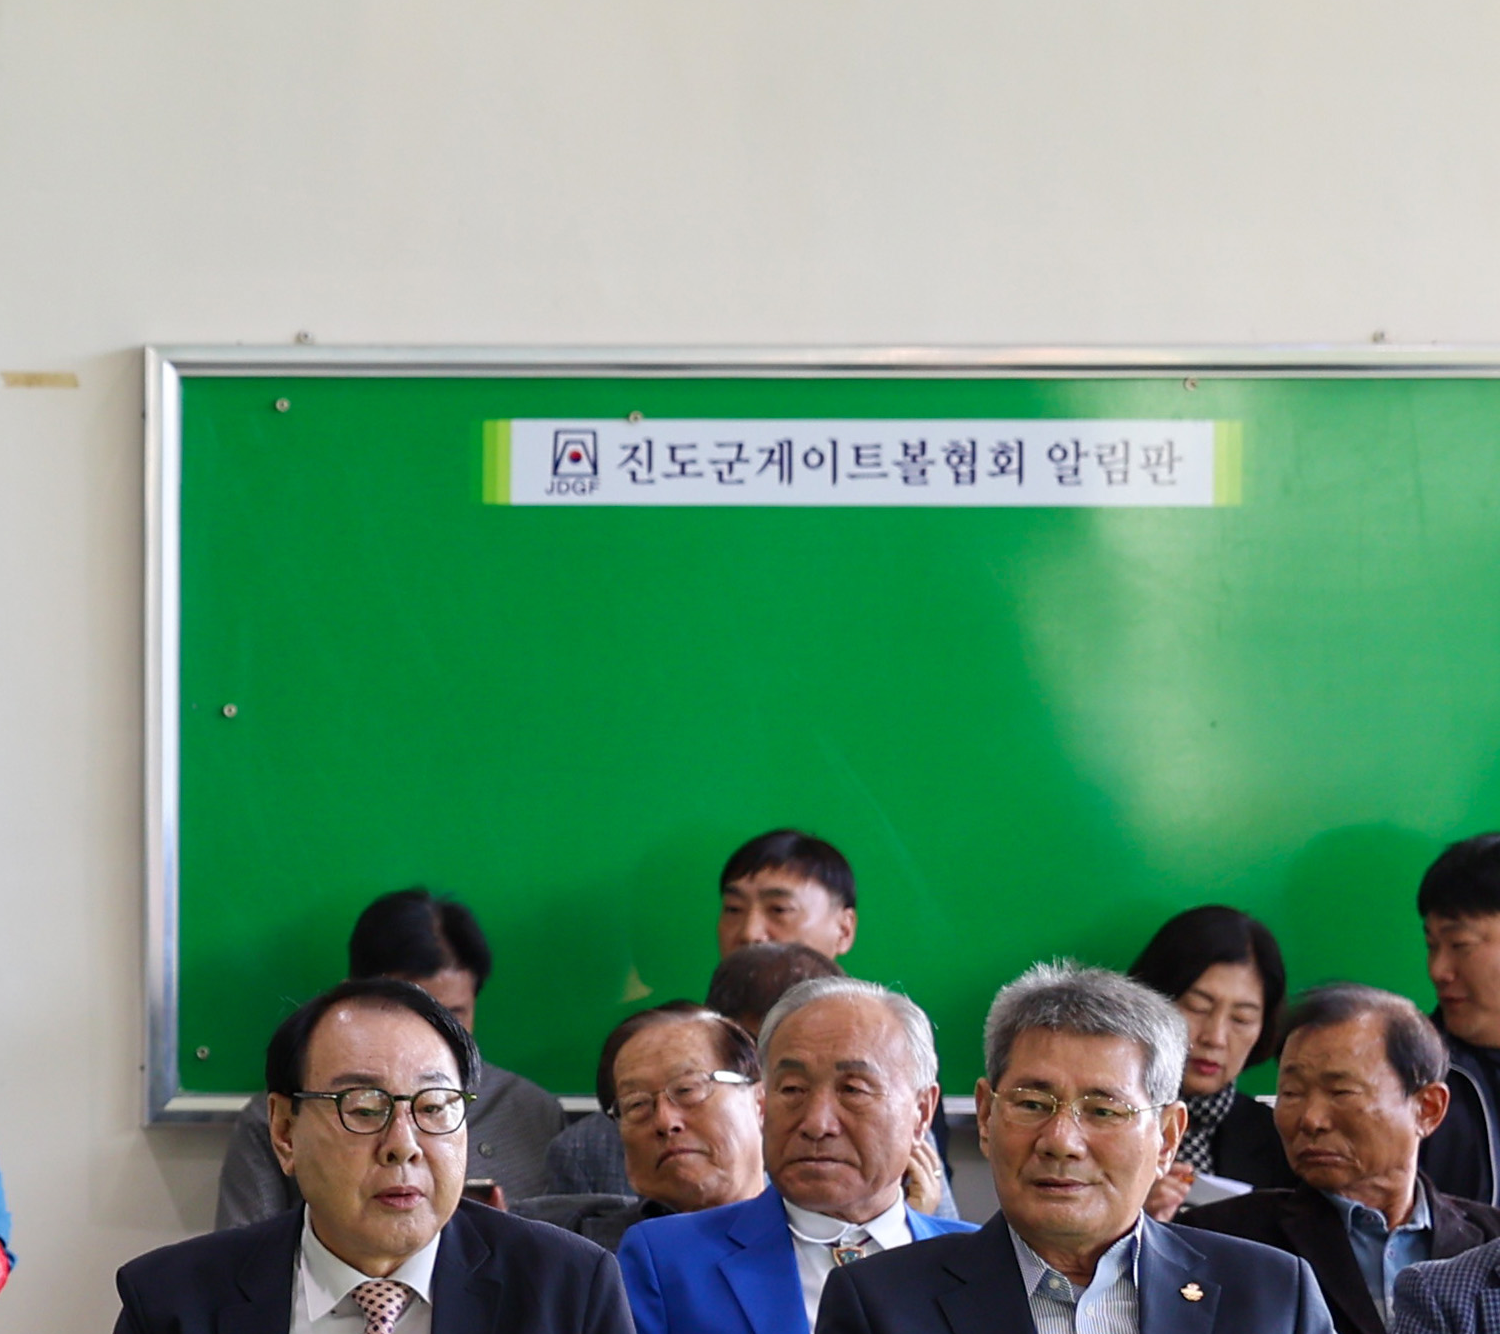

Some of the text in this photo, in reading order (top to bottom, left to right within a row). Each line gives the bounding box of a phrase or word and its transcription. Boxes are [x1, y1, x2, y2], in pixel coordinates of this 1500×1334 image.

[616, 437, 1184, 489] 진도군게이트볼협회 알림판
[545, 478, 601, 496] JDGF
